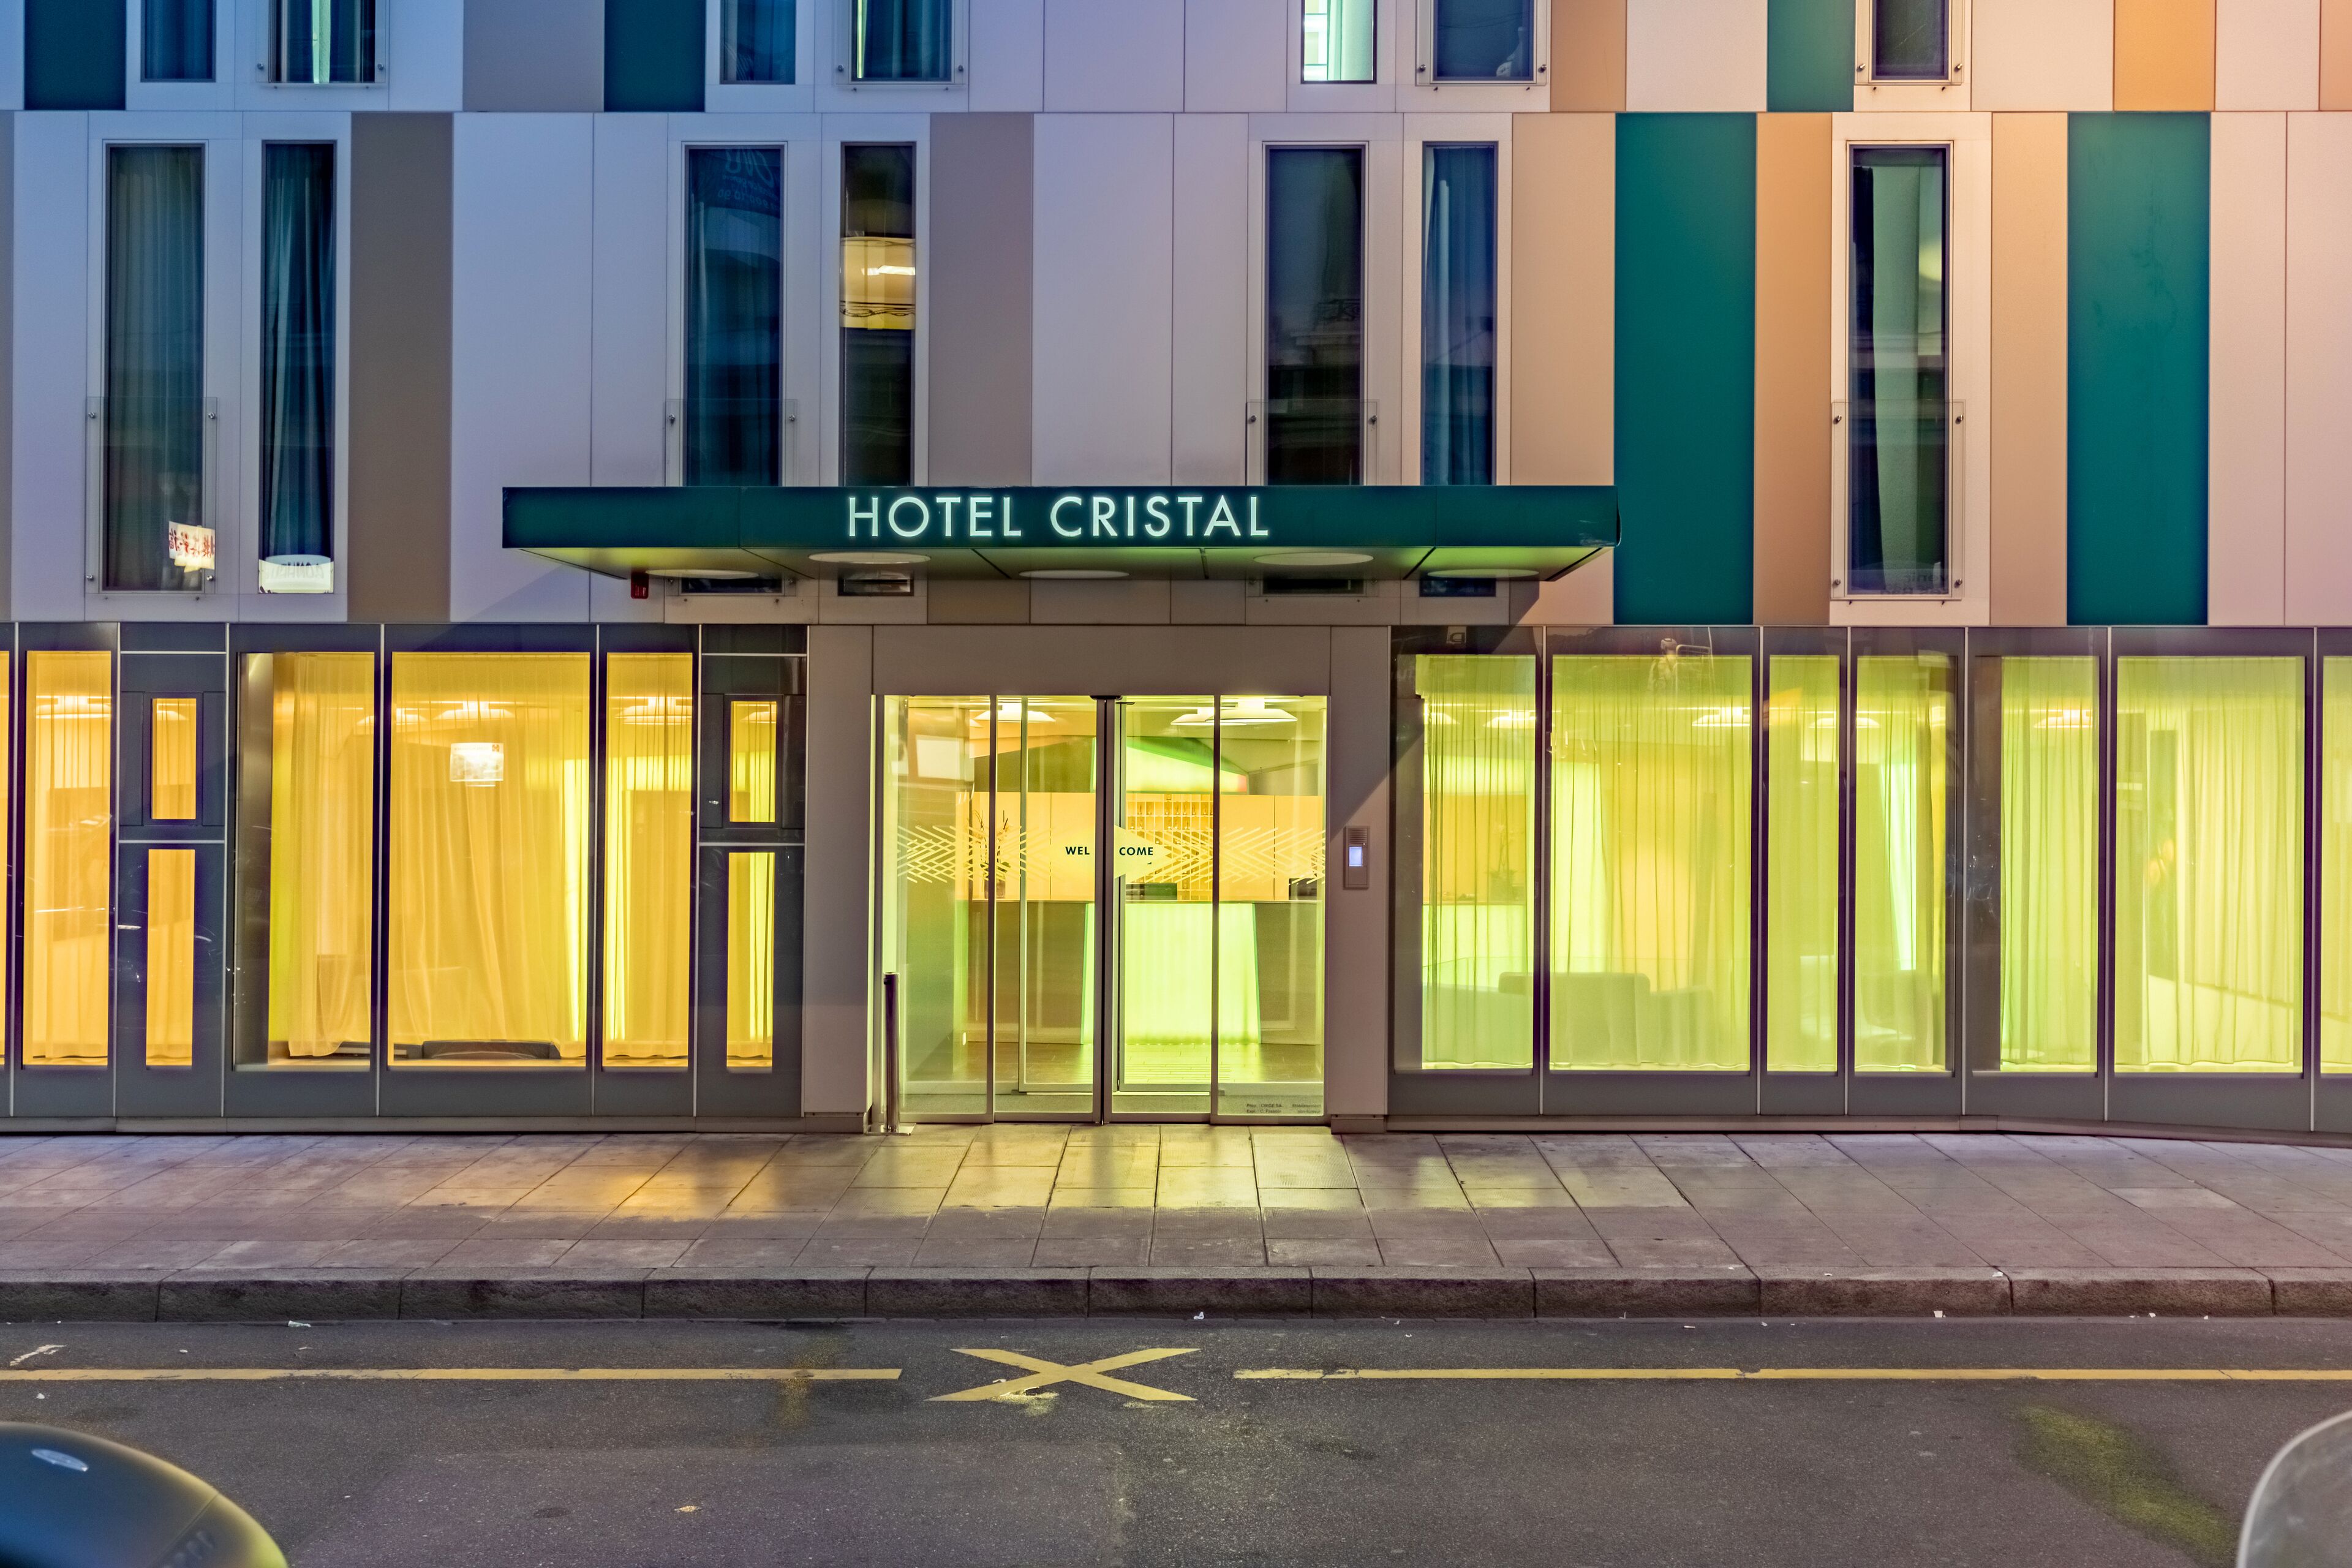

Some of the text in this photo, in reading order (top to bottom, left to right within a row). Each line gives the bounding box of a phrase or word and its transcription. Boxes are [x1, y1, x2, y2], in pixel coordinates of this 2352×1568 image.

[849, 495, 1268, 538] HOTEL CRISTAL
[1065, 846, 1153, 856] WEL COME
